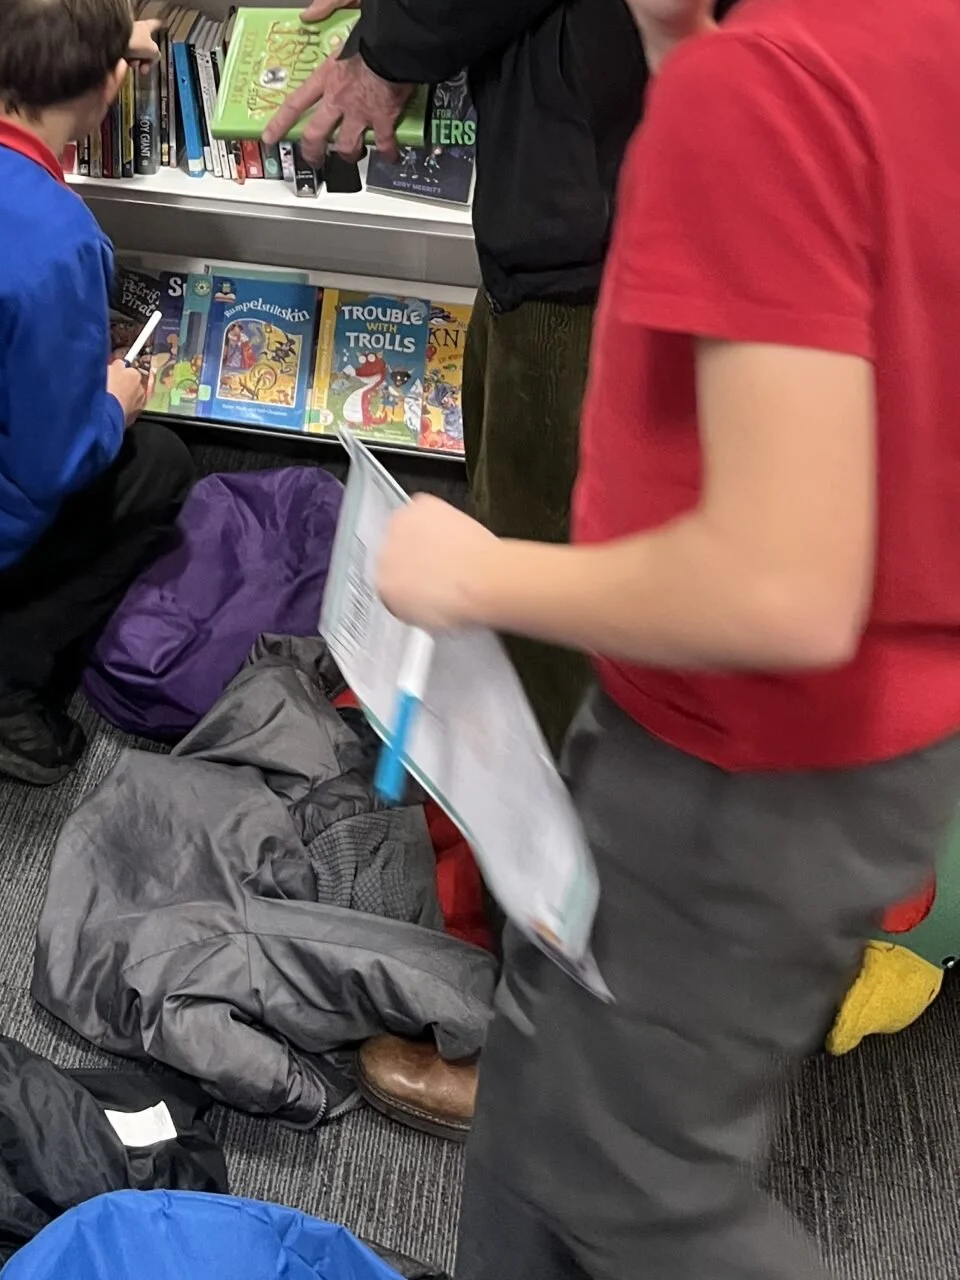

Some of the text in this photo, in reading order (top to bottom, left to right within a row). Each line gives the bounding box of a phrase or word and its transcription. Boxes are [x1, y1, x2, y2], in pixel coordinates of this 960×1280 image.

[436, 108, 452, 118] FOR
[432, 121, 476, 146] TERS
[140, 134, 151, 157] GIANT
[392, 180, 443, 193] KORY MERRITT
[123, 278, 160, 304] Petrif
[122, 292, 156, 316] Pirat
[224, 298, 310, 322] Rumpelstiltskin
[342, 306, 424, 326] TROUBLE
[366, 322, 398, 333] WITH
[346, 332, 416, 354] TROLLS
